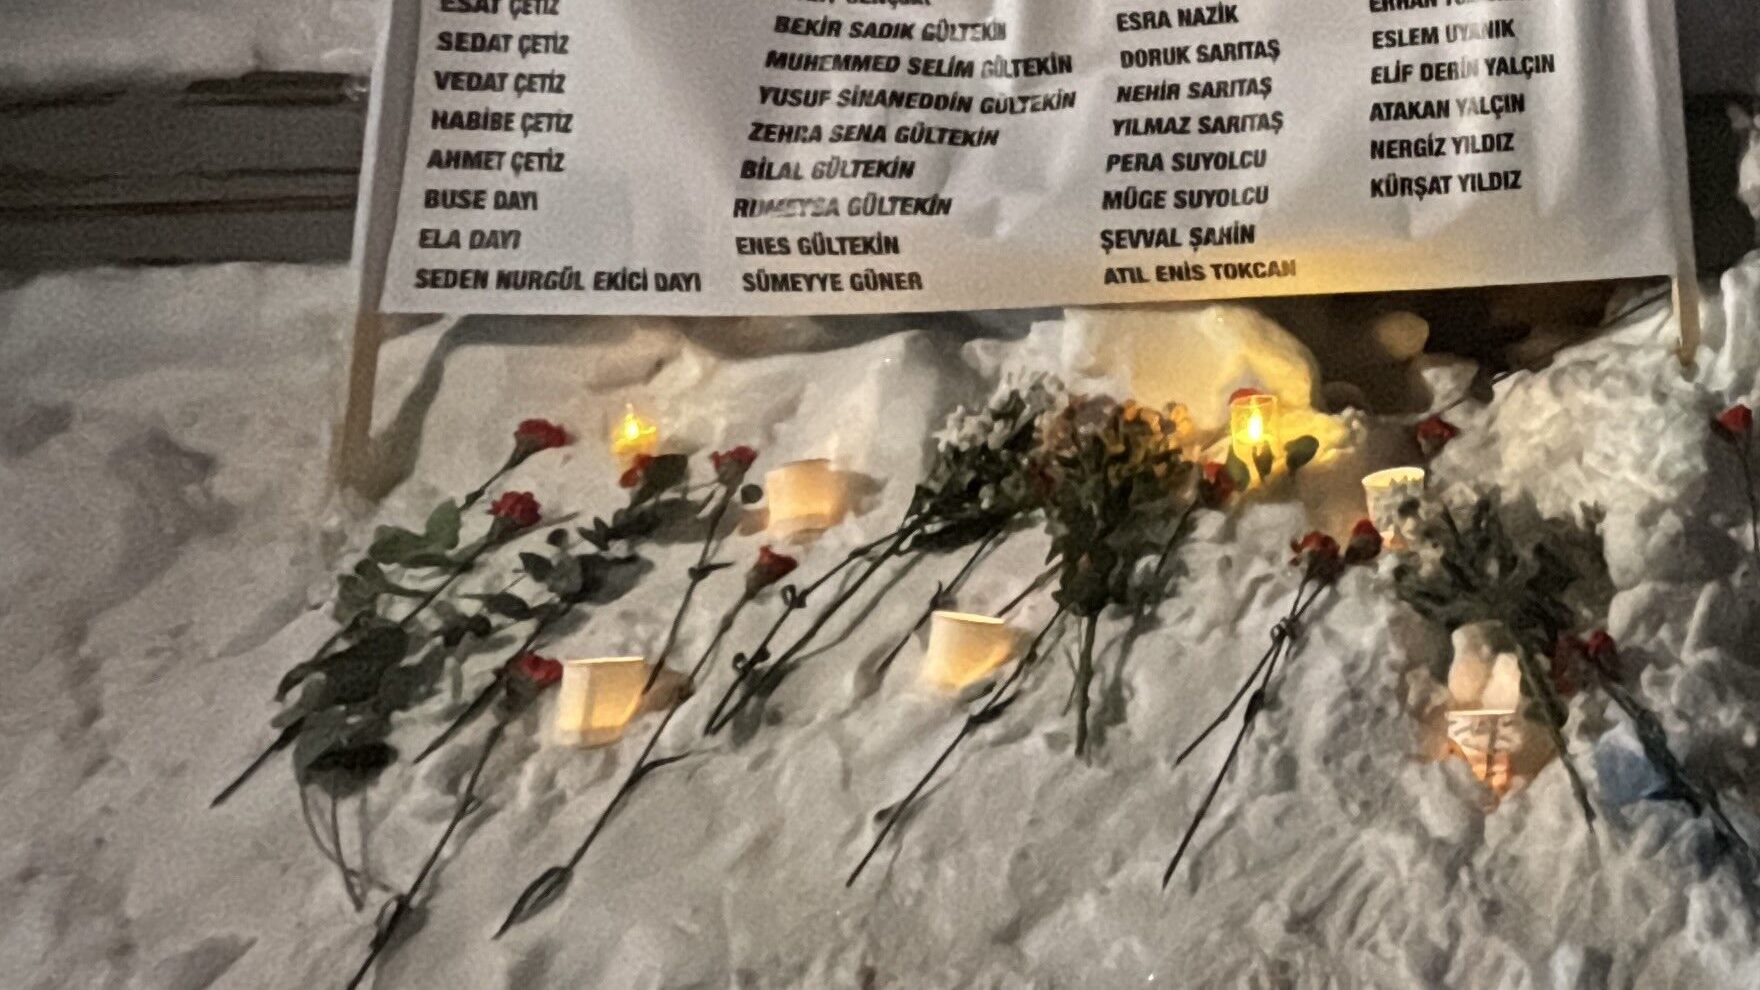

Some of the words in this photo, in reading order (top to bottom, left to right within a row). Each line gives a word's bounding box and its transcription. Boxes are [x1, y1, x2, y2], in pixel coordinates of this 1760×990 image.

[774, 15, 842, 37] BEKİR
[848, 22, 916, 41] SADIK
[1116, 10, 1172, 32] ESRA
[1177, 1, 1239, 27] NAZİK
[436, 31, 513, 52] SEDAT
[518, 31, 569, 59] ÇETİZ
[1372, 27, 1439, 49] ESLEM
[907, 55, 975, 78] SELİM
[1120, 45, 1191, 69] DORUK
[1196, 39, 1281, 64] SARITAŞ
[1371, 60, 1413, 84] ELİF
[1484, 54, 1555, 80] YALÇIN
[434, 71, 509, 92] VEDAT
[514, 69, 567, 98] ÇETİZ
[1117, 80, 1180, 103] NEHİR
[1187, 77, 1272, 100] SARITAŞ
[759, 86, 831, 107] YUSUF
[1369, 100, 1450, 121] ATAKAN
[1456, 94, 1525, 119] YALÇIN
[431, 107, 516, 132] HABİBE
[1112, 116, 1191, 136] YILMAZ
[1198, 111, 1284, 135] SARITAŞ
[748, 122, 822, 143] ZEHRA
[828, 124, 886, 143] SENA
[894, 122, 1000, 147] GÜLTEKİN
[1370, 132, 1446, 160] NERGİZ
[1451, 133, 1514, 154] YILDIZ
[426, 149, 507, 170] AHMET
[510, 147, 565, 177] ÇETİZ
[740, 155, 804, 180] BİLAL
[811, 155, 915, 179] GÜLTEKİN
[1106, 153, 1165, 173] PERA
[1171, 149, 1267, 172] SUYOLCU
[1102, 186, 1167, 211] MÜGE
[1173, 185, 1269, 209] SUYOLCU
[1370, 173, 1452, 201] KÜRŞAT
[1458, 170, 1521, 192] YILDIZ
[424, 189, 487, 209] BUSE
[494, 190, 538, 210] DAYI
[847, 192, 953, 217] GÜLTEKİN
[418, 228, 460, 249] ELA
[469, 230, 521, 250] DAYI
[736, 236, 790, 255] ENES
[797, 231, 900, 256] GÜLTEKİN
[1100, 228, 1182, 255] ŞEVVAL
[1189, 220, 1256, 252] ŞAHİN
[414, 268, 489, 289] SEDEN
[496, 266, 585, 291] NURGÜL
[655, 272, 701, 292] DAYI
[742, 269, 844, 292] SÜMEYYE
[850, 268, 923, 291] GÜNER
[1156, 260, 1206, 282] ENİS
[1210, 259, 1296, 280] TOKCAN
